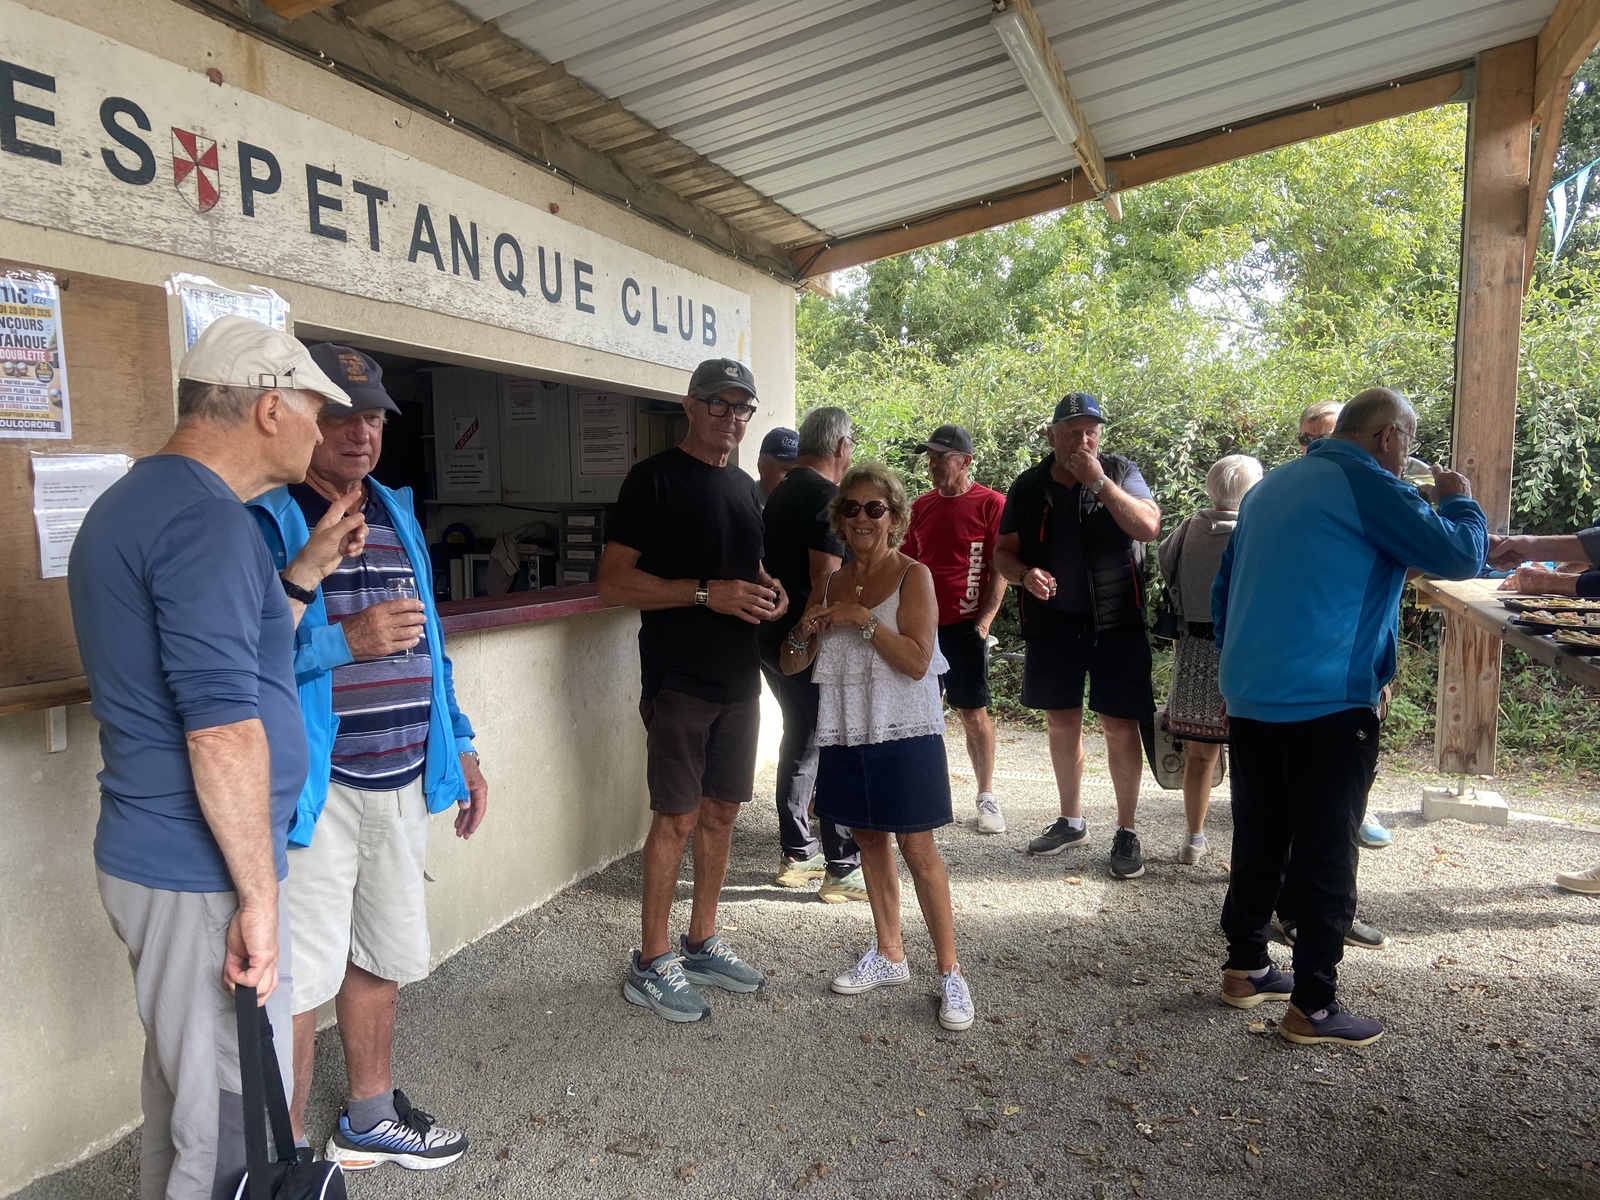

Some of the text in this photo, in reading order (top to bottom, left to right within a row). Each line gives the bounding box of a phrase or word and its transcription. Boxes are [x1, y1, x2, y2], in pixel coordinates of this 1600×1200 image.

[0, 60, 718, 348] ES PETANQUE CLUB
[0, 349, 45, 360] DOUBLETTE
[959, 541, 987, 615] Kempa
[643, 979, 664, 1001] HOKA
